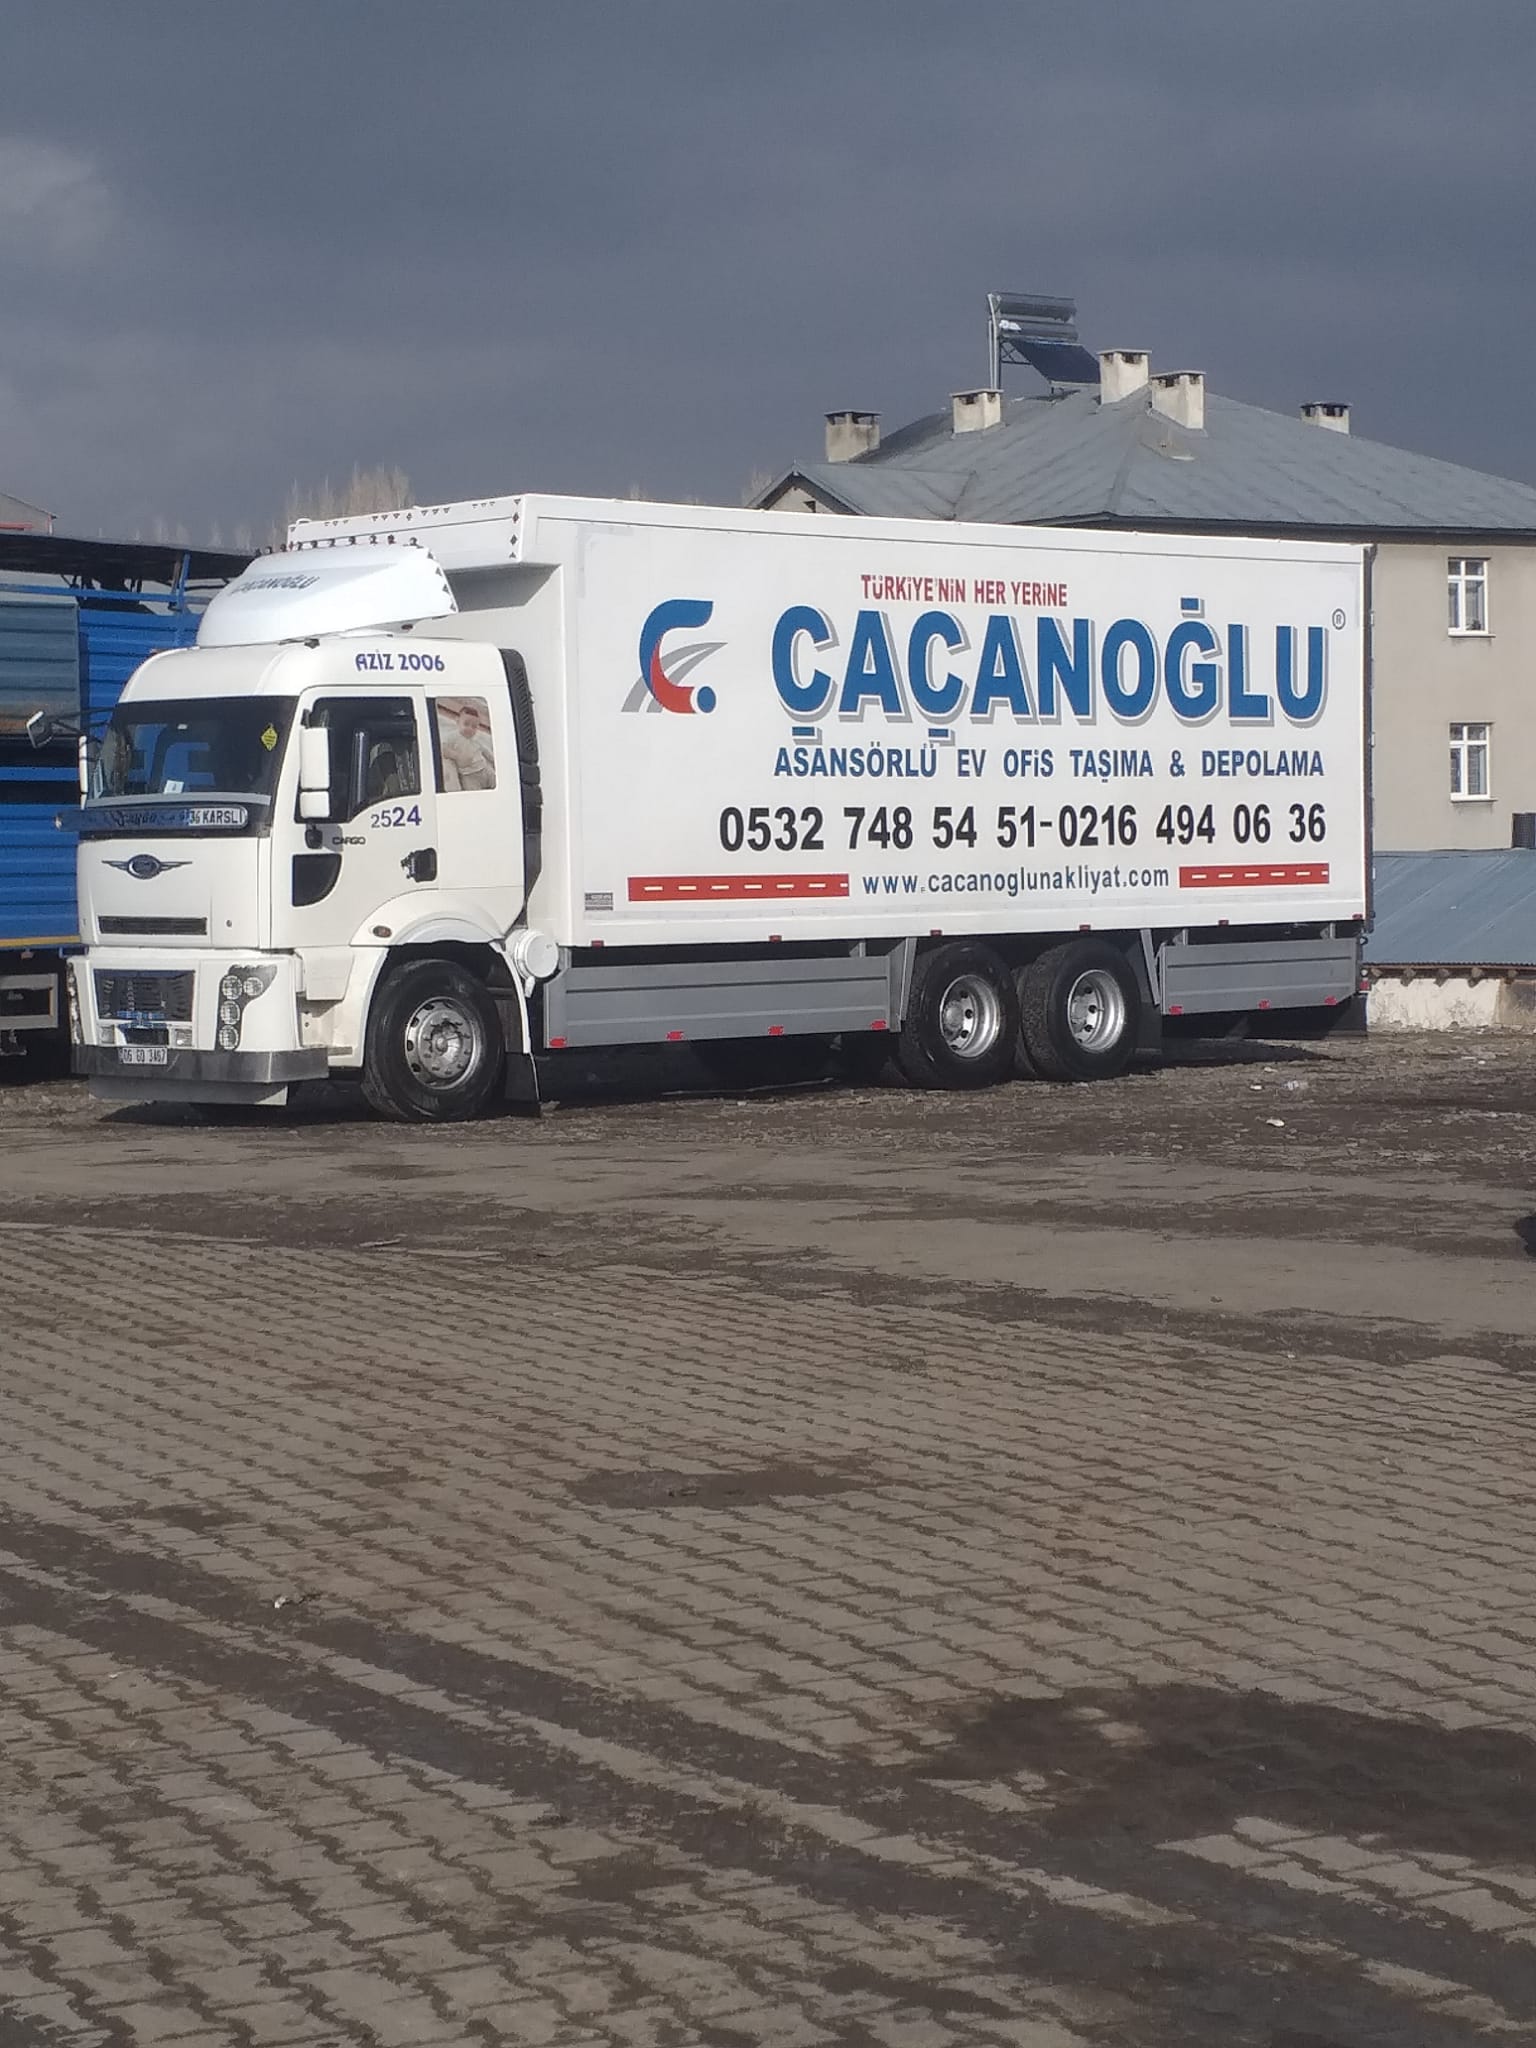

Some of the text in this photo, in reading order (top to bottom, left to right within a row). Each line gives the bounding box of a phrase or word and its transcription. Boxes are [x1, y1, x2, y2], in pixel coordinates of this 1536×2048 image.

[974, 580, 1006, 604] HER
[397, 653, 445, 671] 2006
[771, 597, 1329, 745] ÇAÇANOĞLU
[774, 741, 937, 777] ASANSÖRLÜ
[957, 749, 986, 777] EV
[1070, 749, 1153, 782] TAŞIMA
[1170, 749, 1185, 777] &
[1202, 749, 1324, 777] DEPOLAMA
[202, 810, 243, 824] KARSLI
[370, 804, 422, 829] 2524
[720, 806, 824, 851] 0532
[843, 806, 913, 850] 748
[933, 806, 977, 849] 54
[1156, 804, 1216, 845] 494
[1233, 803, 1271, 844] 06
[1288, 803, 1326, 843] 36
[863, 865, 1169, 898] www.cacanoglunakliyat.com
